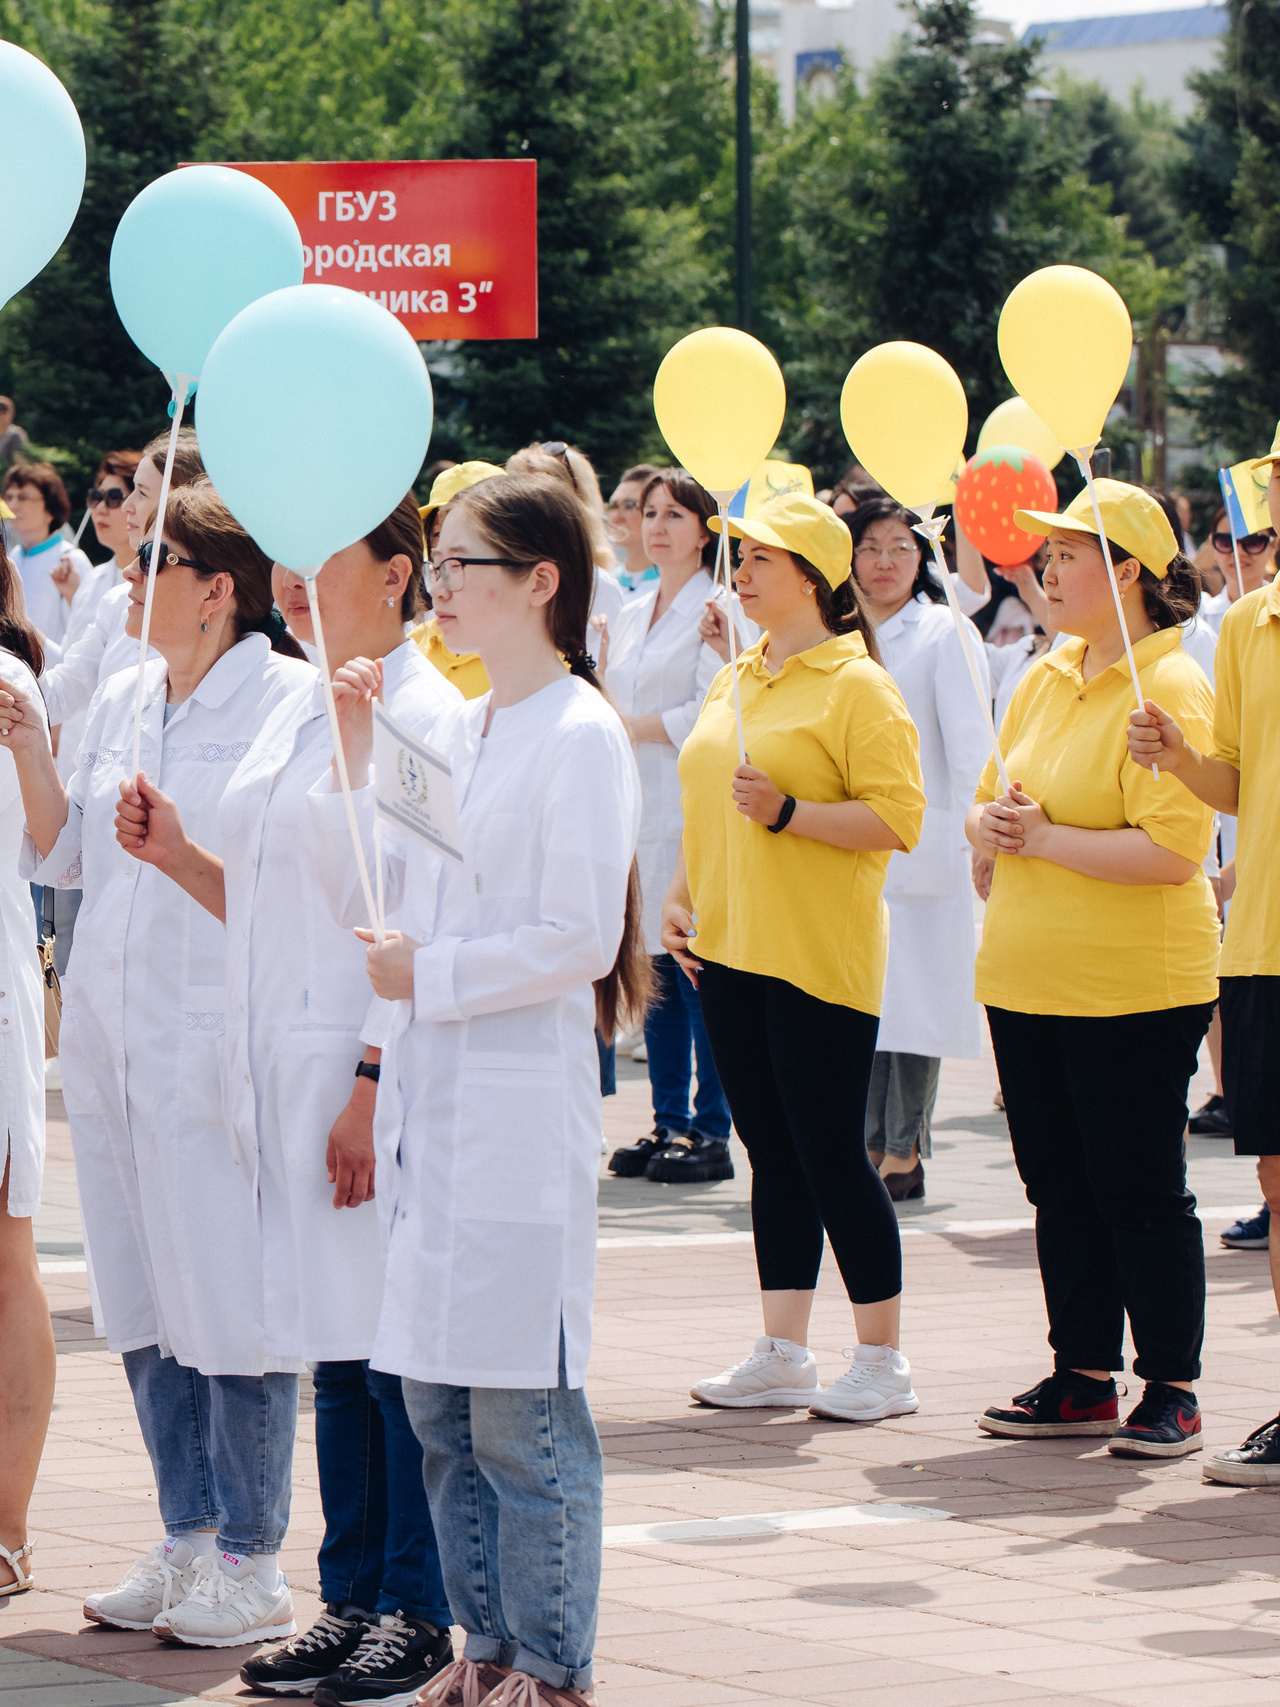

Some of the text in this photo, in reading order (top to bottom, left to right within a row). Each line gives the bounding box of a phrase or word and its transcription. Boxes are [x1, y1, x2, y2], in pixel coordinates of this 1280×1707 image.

[318, 190, 397, 221] ГБУЗ
[302, 244, 451, 275] ородская
[361, 289, 448, 314] ника
